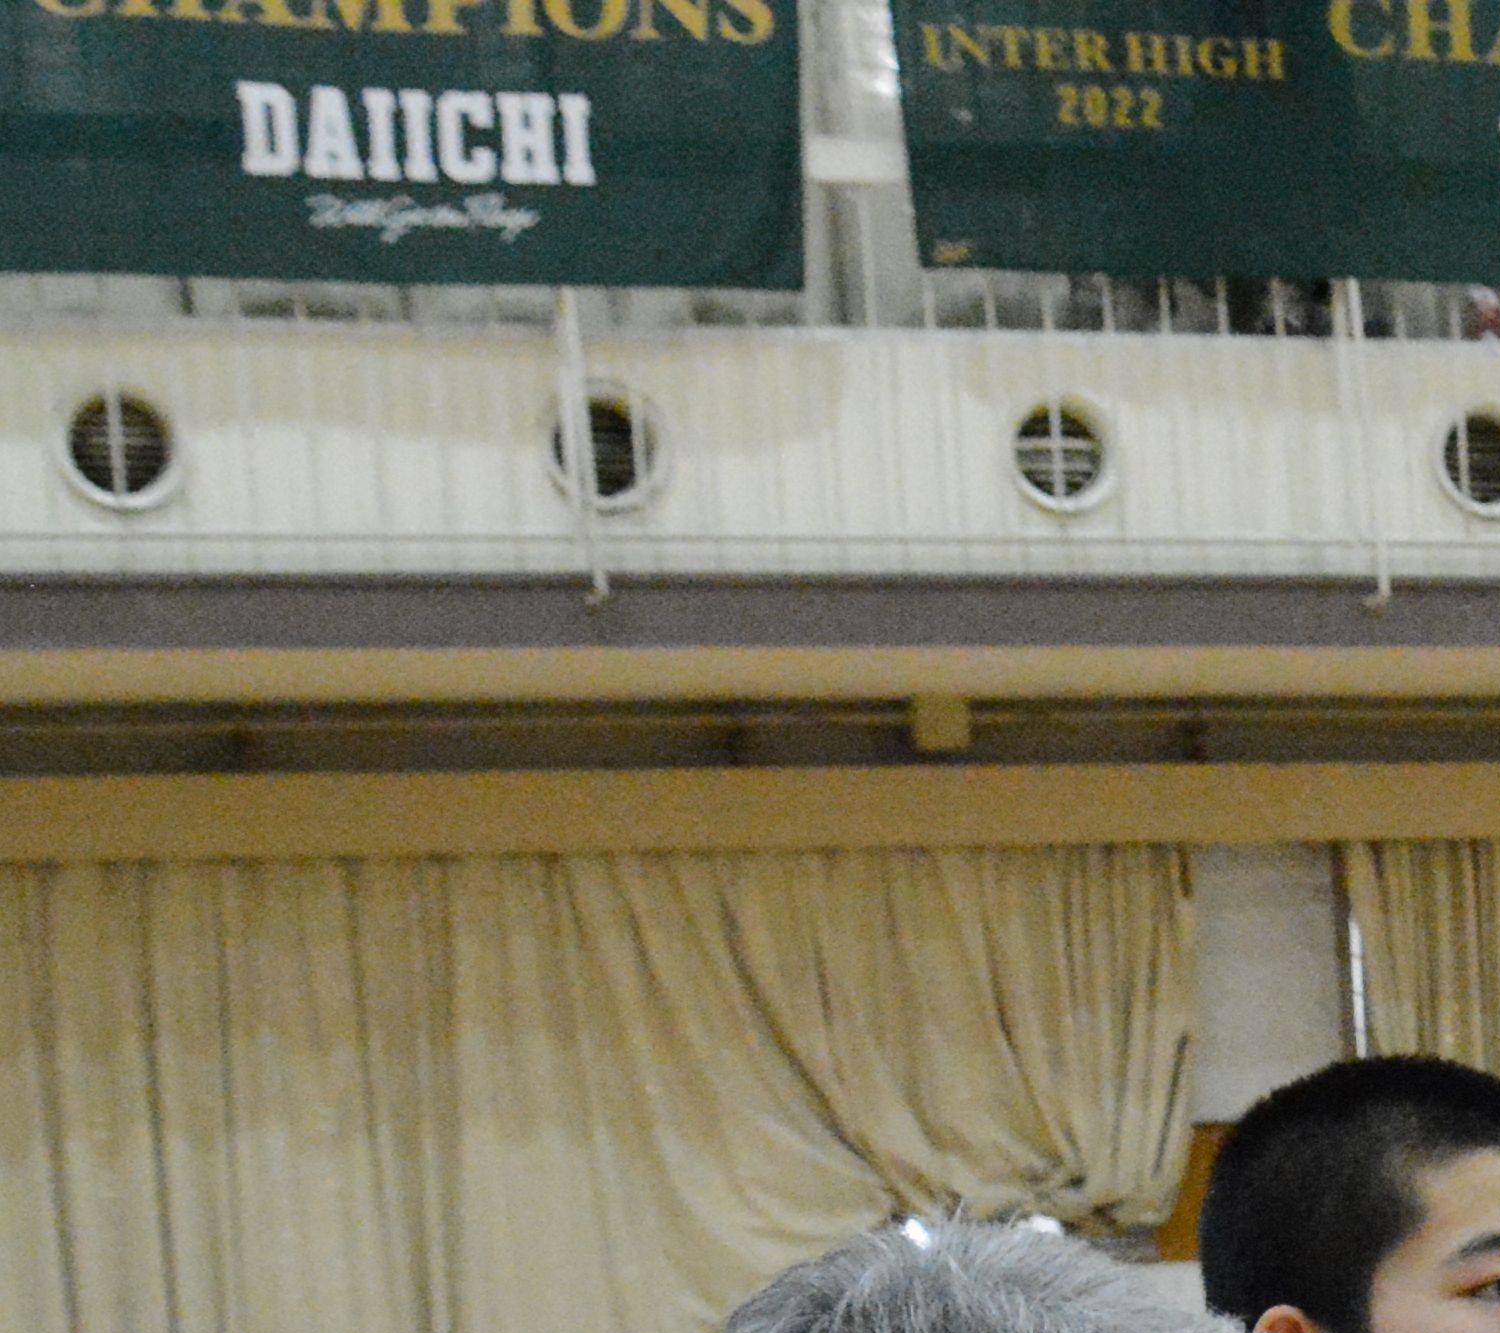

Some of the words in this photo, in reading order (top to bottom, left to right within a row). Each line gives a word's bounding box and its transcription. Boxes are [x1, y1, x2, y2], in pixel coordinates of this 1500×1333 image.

[921, 22, 1114, 73] INTER
[1123, 30, 1287, 81] HIGH
[235, 79, 598, 187] DAIICHI
[1055, 84, 1164, 129] 2022
